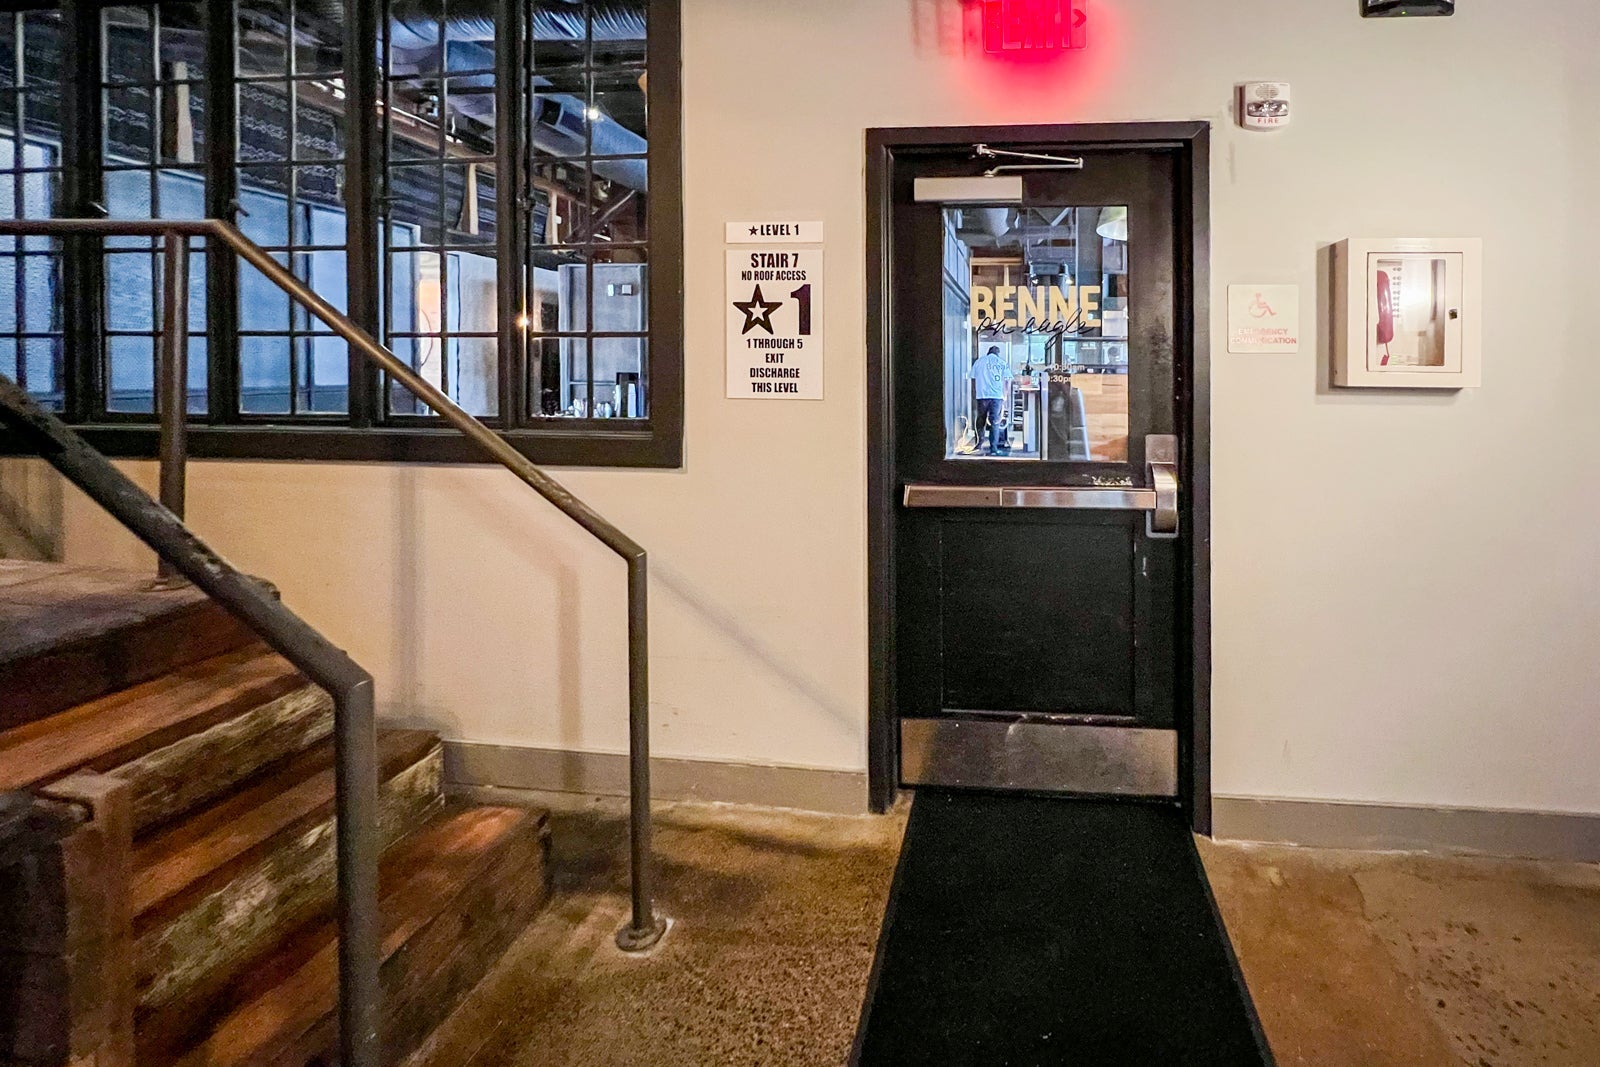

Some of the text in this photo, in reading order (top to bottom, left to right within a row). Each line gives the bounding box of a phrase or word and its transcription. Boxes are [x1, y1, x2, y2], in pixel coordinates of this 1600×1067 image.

[760, 224, 800, 236] LEVEL 1
[750, 252, 799, 268] STAIR 7
[741, 270, 807, 281] NO ROOF ACCESS
[790, 284, 811, 336] 1
[970, 285, 1102, 328] BENNE
[746, 338, 803, 349] 1 THROUGH 5
[765, 353, 785, 364] EXIT
[749, 367, 801, 379] DISCHARGE
[751, 382, 799, 393] THIS LEVEL
